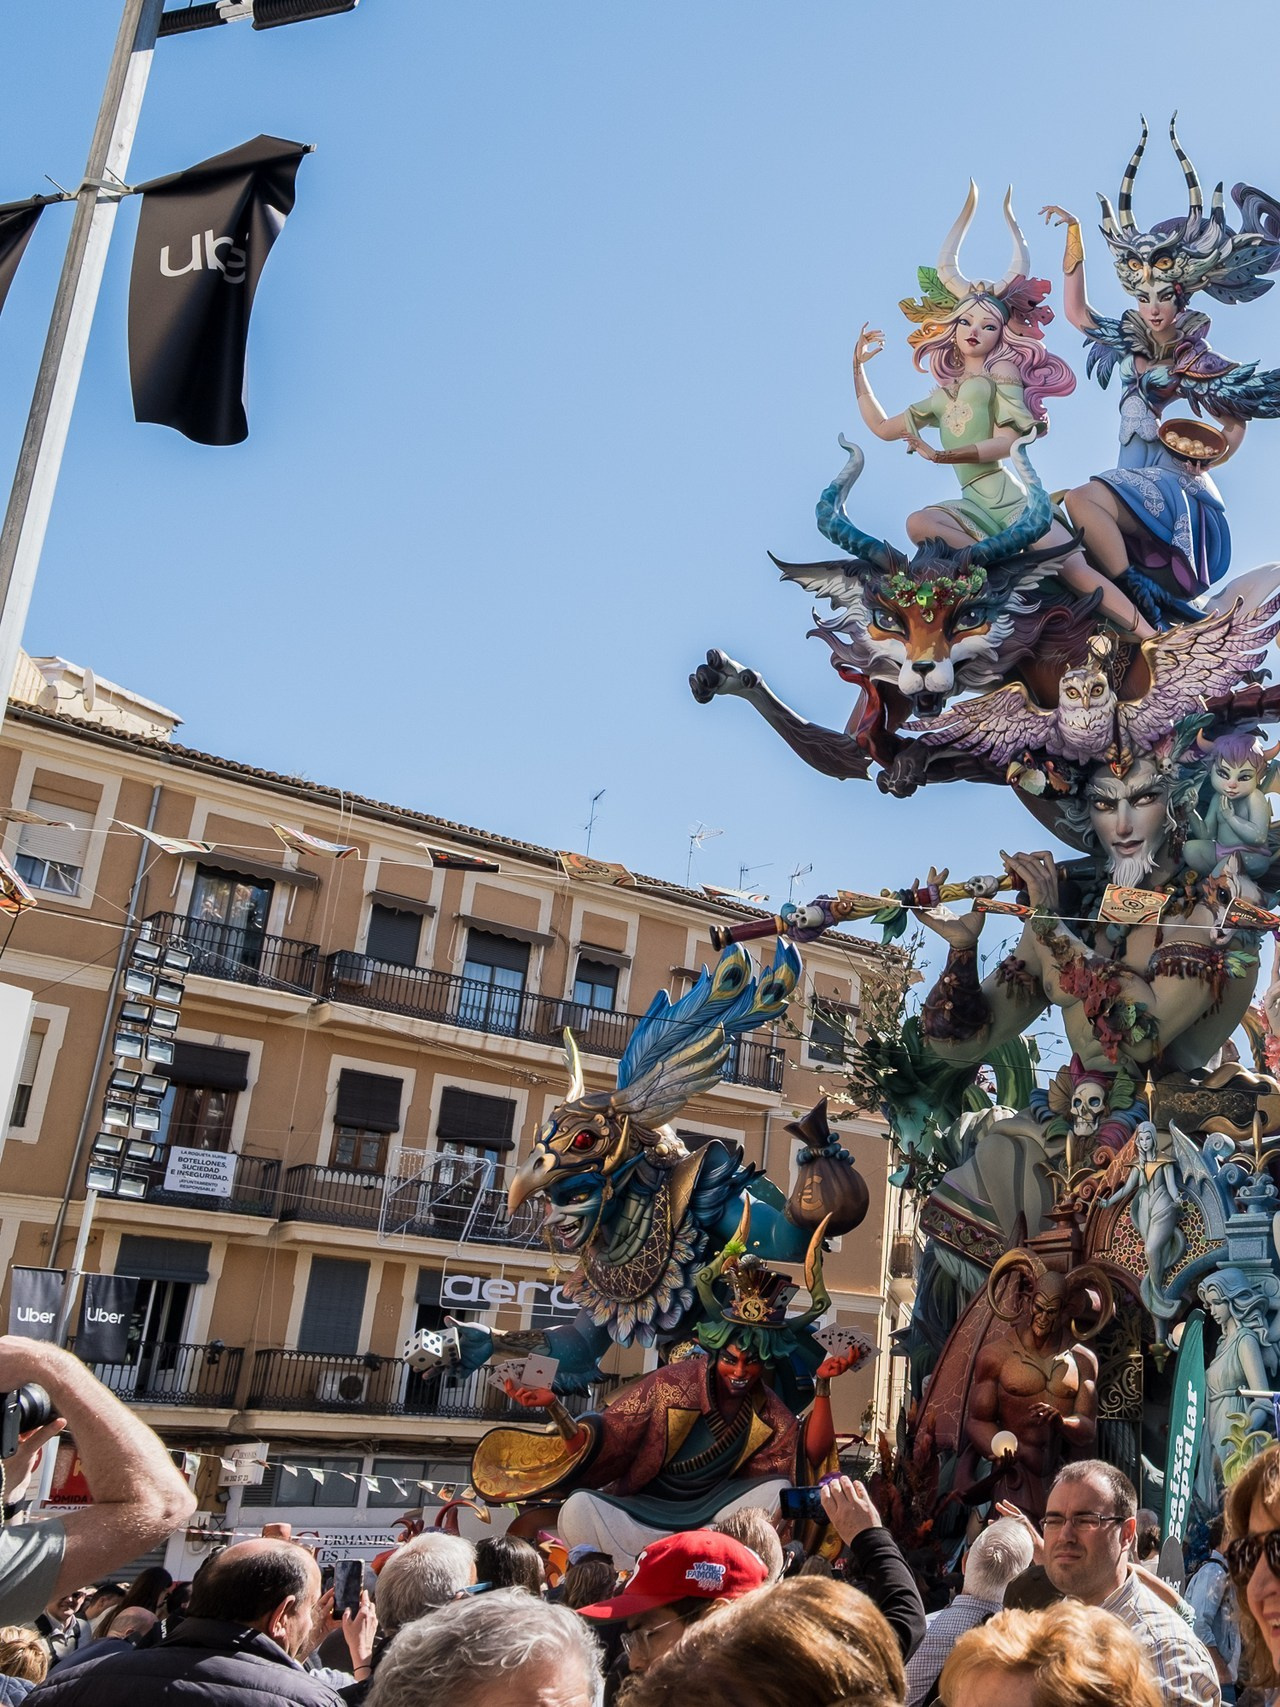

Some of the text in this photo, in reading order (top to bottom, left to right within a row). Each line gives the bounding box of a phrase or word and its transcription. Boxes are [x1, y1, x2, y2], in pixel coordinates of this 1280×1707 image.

[177, 1156, 227, 1169] BOTELLONES,
[181, 1163, 220, 1174] SUCIEDAD
[176, 1169, 229, 1182] INSEGURIDAD.
[17, 1306, 56, 1324] Uber
[87, 1306, 125, 1325] Uber
[1175, 1380, 1198, 1545] popular
[50, 1495, 88, 1504] OMIDA
[694, 1561, 725, 1573] WORLD
[686, 1570, 722, 1581] FAMOUS
